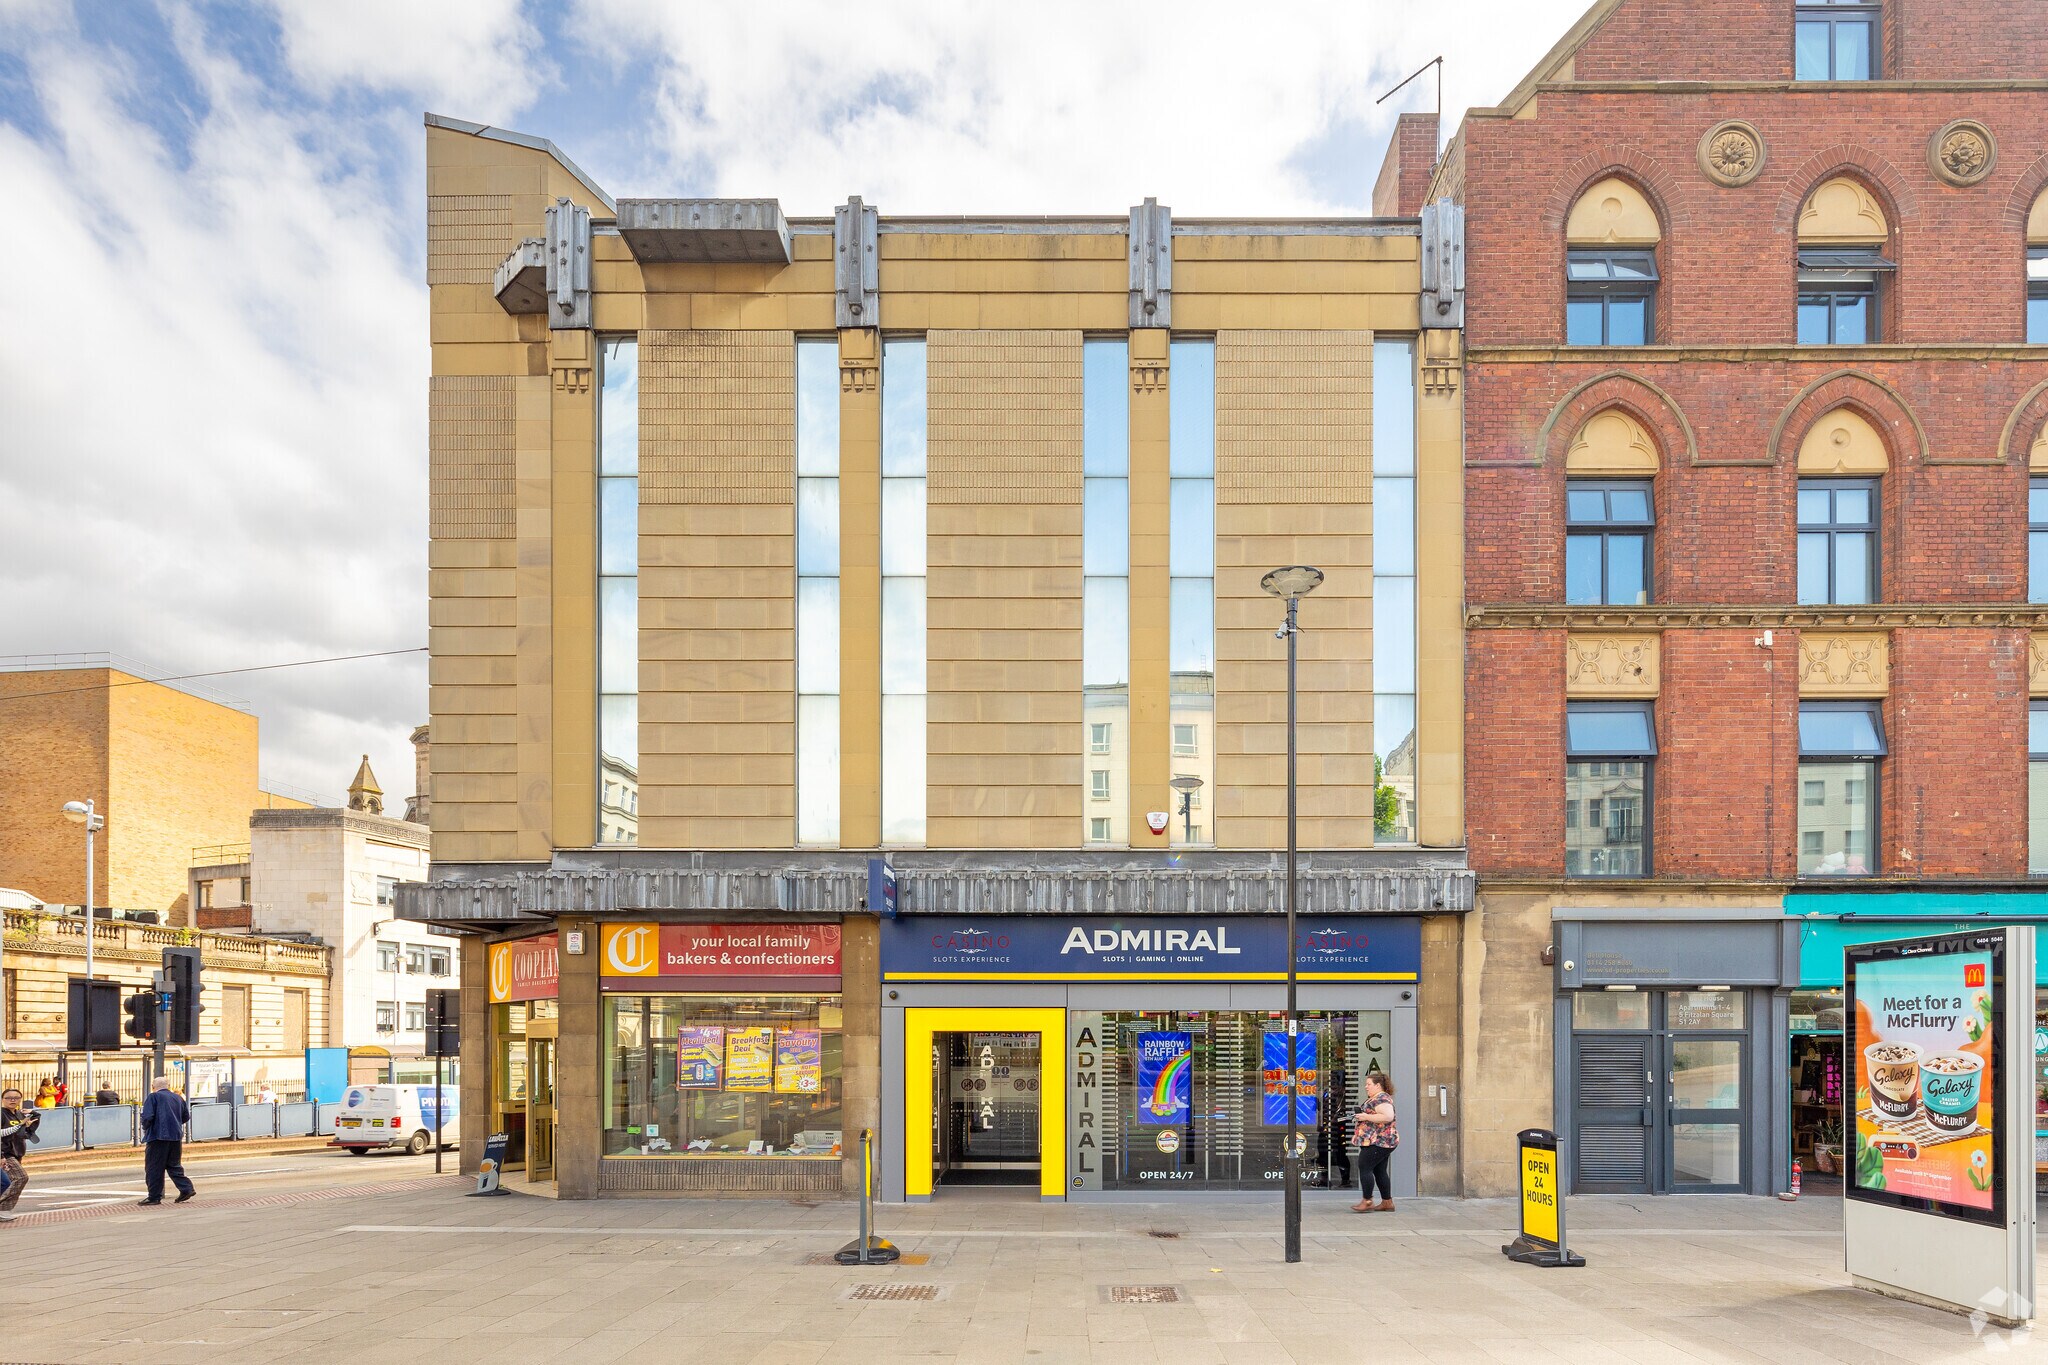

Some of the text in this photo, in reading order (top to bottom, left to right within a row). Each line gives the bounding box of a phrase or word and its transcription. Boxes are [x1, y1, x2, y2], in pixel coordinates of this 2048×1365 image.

[691, 934, 811, 950] your local family
[931, 935, 1011, 949] CASINO
[1059, 926, 1241, 955] ADMIRAL
[666, 952, 835, 965] bakers & confectioners
[1883, 994, 1962, 1011] Meet for a
[1711, 1011, 1735, 1019] Square
[1887, 1013, 1957, 1032] McFlurry
[731, 1035, 770, 1045] Breakfast
[779, 1038, 818, 1048] Savoury
[1144, 1040, 1185, 1048] RAINBOW
[733, 1044, 751, 1053] Deal
[1144, 1047, 1185, 1057] RAFFLE
[1874, 1065, 1915, 1086] Galaxy
[1927, 1078, 1974, 1098] Galaxy
[1075, 1027, 1098, 1173] ADMIRAL
[1527, 1159, 1550, 1175] OPEN
[1139, 1171, 1194, 1180] OPEN 24/7
[1263, 1171, 1319, 1180] OPE 4/7
[1928, 1172, 1953, 1181] September
[1534, 1176, 1544, 1189] 24
[1526, 1189, 1554, 1207] HOURS
